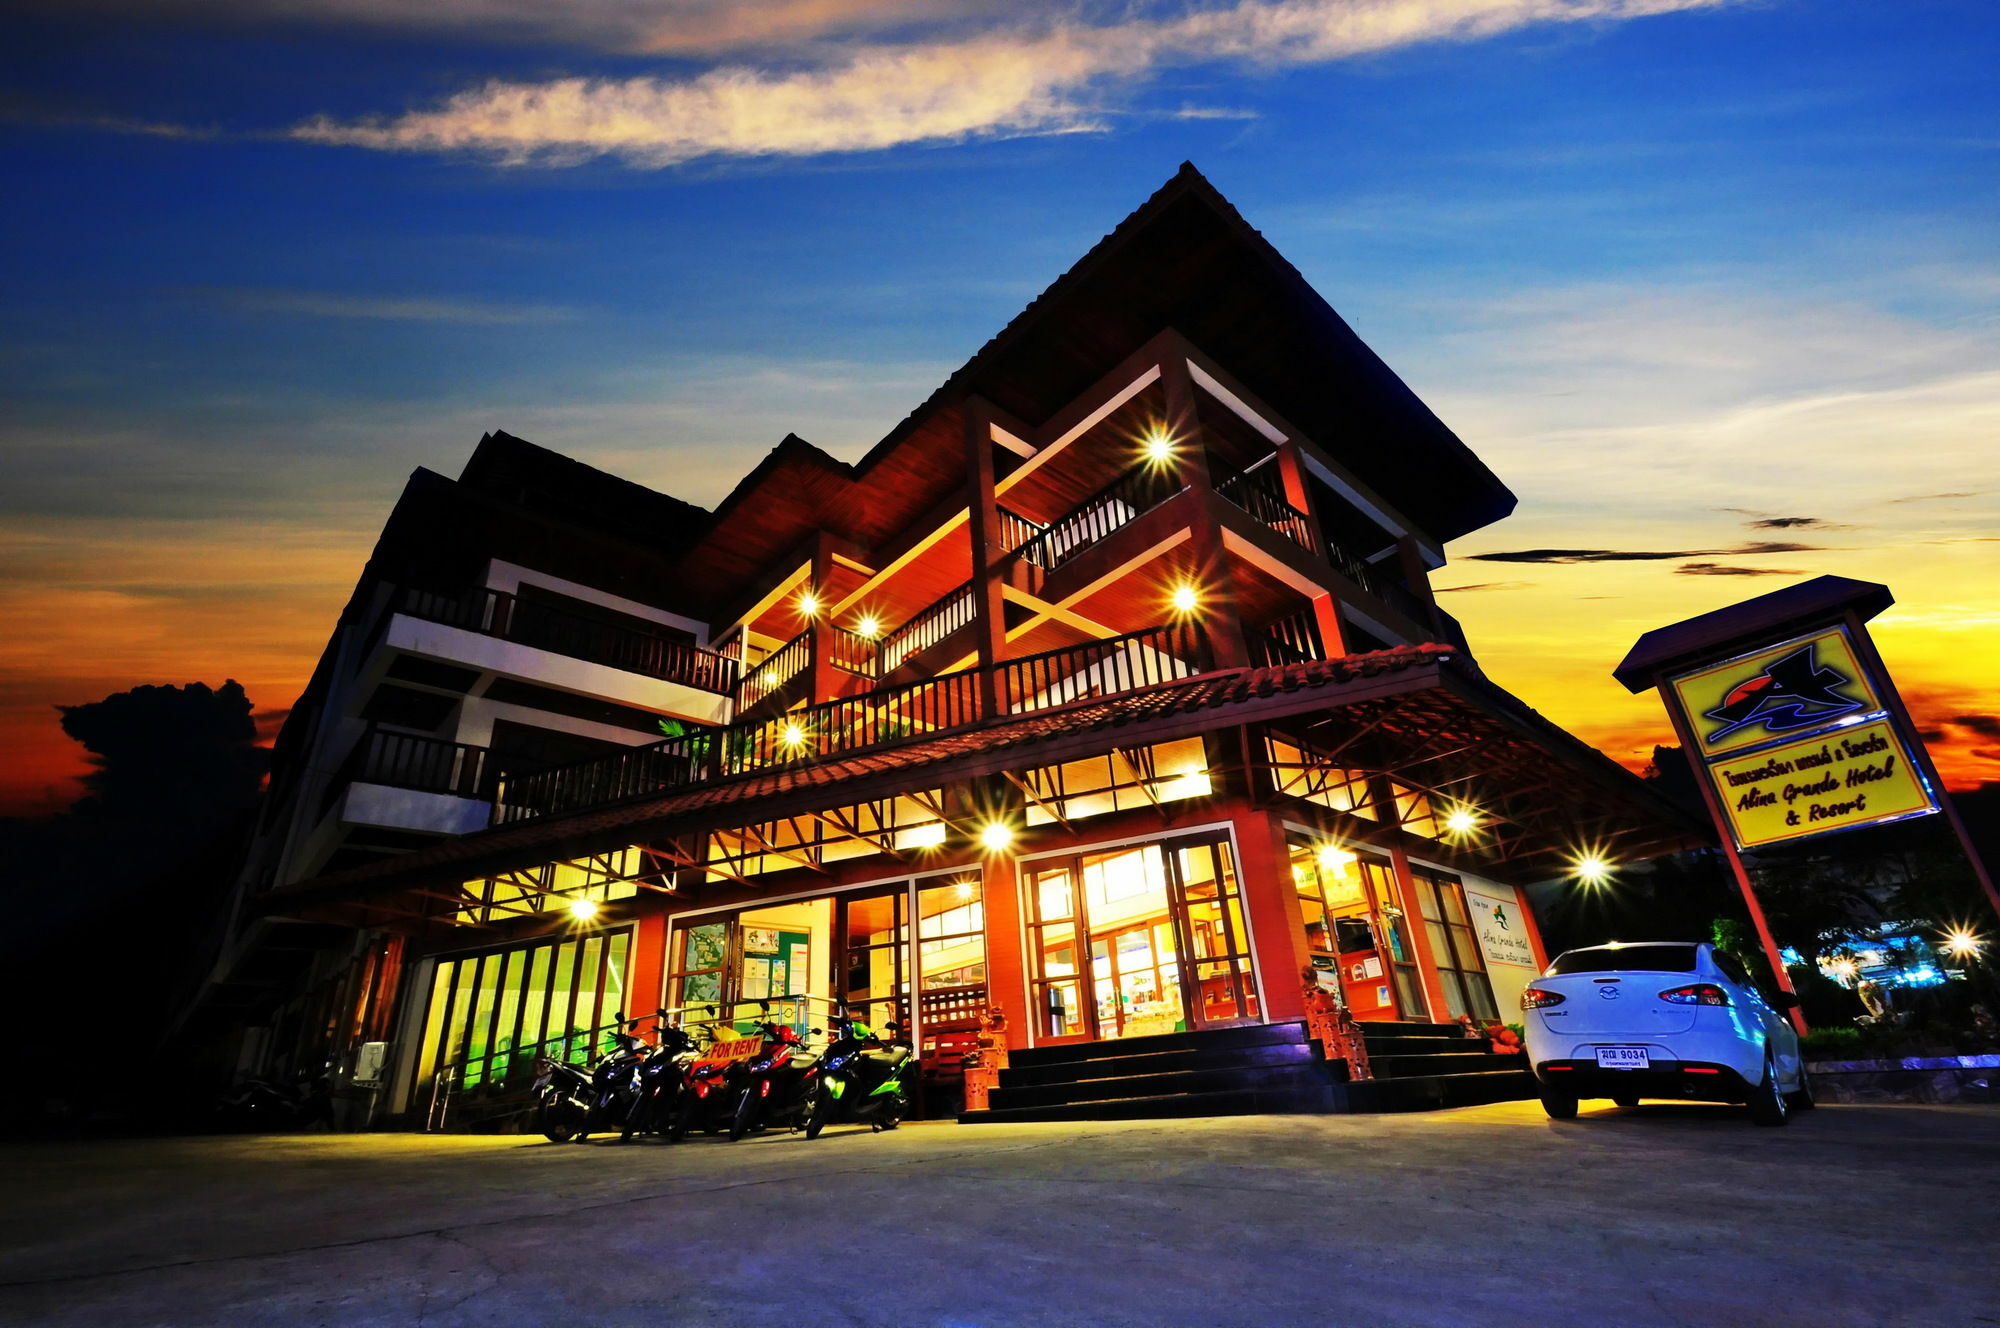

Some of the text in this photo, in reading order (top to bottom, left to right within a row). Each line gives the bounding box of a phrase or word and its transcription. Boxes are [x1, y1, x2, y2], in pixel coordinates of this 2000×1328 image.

[1737, 755, 1895, 812] Alina Grande Hotel
[1785, 793, 1866, 826] & Resort
[711, 1038, 760, 1058] FOR RENT
[1620, 1050, 1646, 1060] 9034
